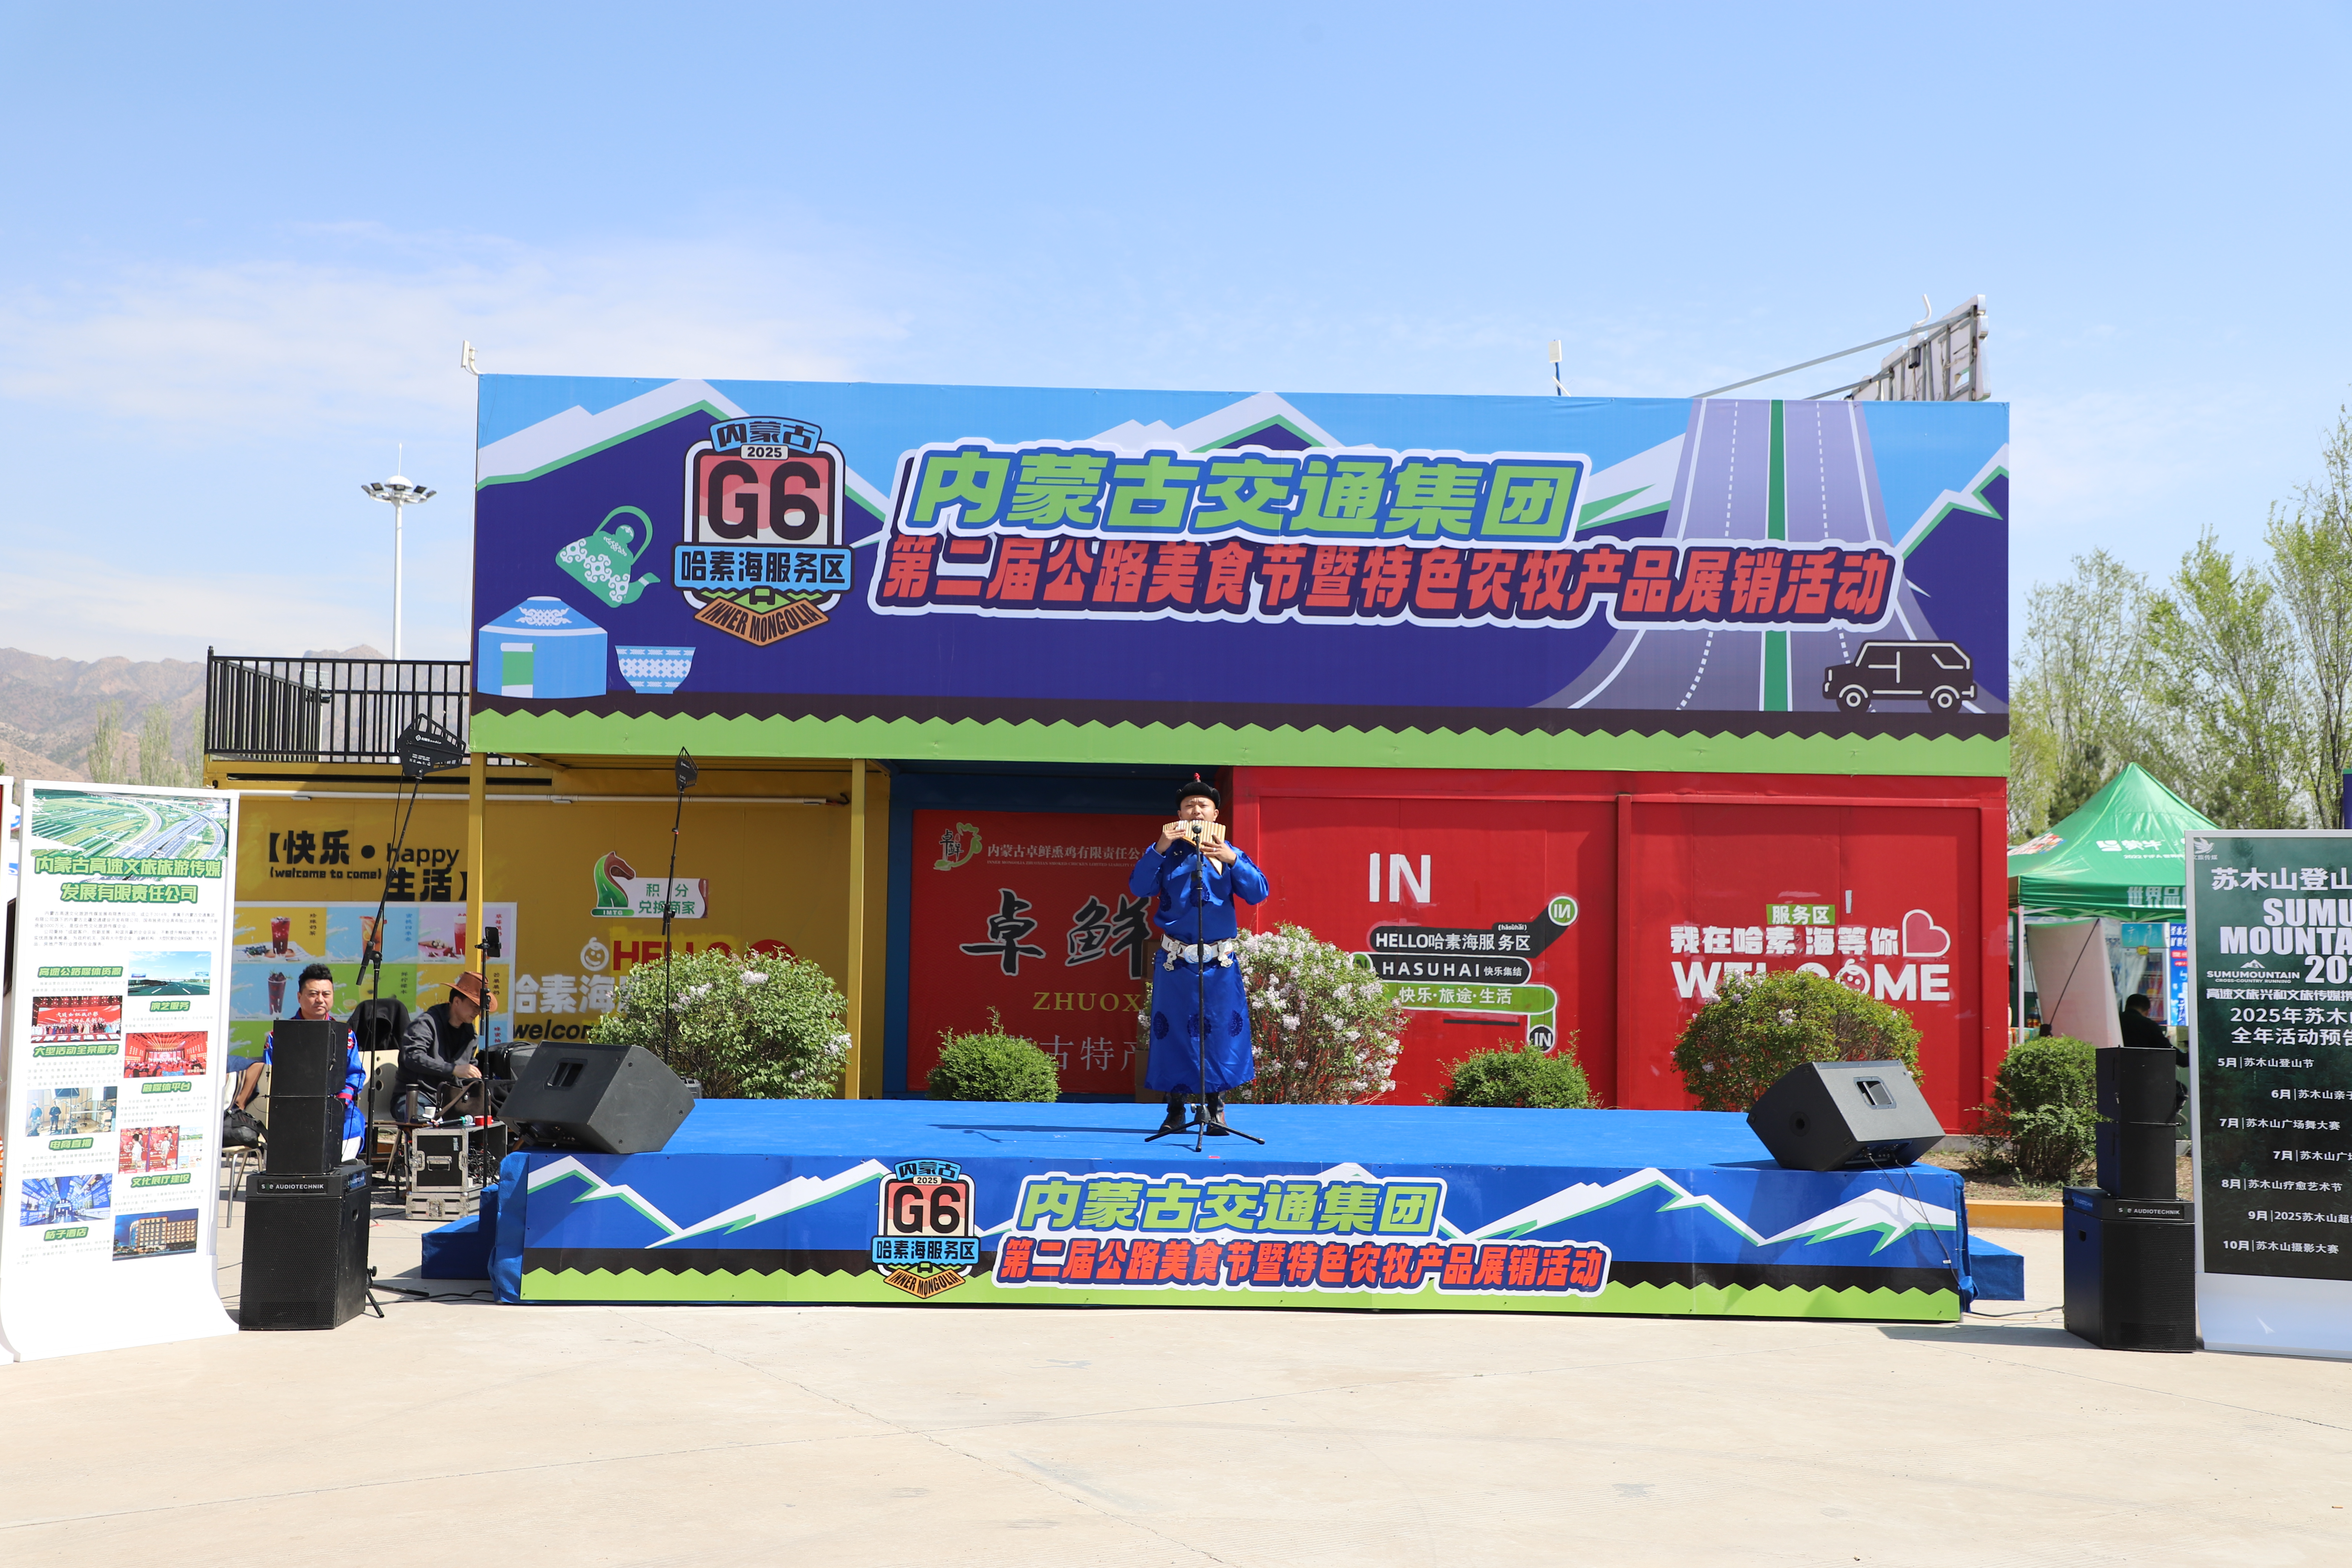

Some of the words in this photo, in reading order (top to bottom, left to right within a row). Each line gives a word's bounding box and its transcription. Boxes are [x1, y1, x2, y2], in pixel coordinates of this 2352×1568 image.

[716, 420, 816, 449] 内蒙古
[747, 447, 782, 458] 2025
[707, 460, 821, 541] G6
[914, 452, 1576, 537] 内蒙古交通集团
[681, 551, 845, 583] 哈素海服务区
[884, 534, 1889, 615] 第二届公路美食节暨特色农牧产品展销活动
[701, 602, 749, 635] INNER
[749, 603, 823, 642] MONGOLIA
[387, 843, 459, 867] happy
[35, 856, 222, 878] 内蒙古高速文旅旅游传媒
[330, 869, 343, 879] to
[1369, 852, 1431, 903] IN
[61, 883, 198, 903] 发展有限责任公司
[639, 900, 695, 915] 兑换商家
[1771, 906, 1831, 925] 服务区
[2263, 898, 2352, 927] SUMU
[959, 887, 1152, 980] 卓鲜
[1670, 925, 1899, 956] 我在哈素海等你
[2220, 926, 2352, 955] MOUNTA
[38, 967, 123, 977] 高速公路媒体资源
[1382, 962, 1480, 977] HASUHAI
[1484, 966, 1523, 977] 快乐集结
[2207, 971, 2300, 979] SUMUMOUNTAIN
[2304, 955, 2352, 984] 20
[515, 974, 637, 1014] 哈素海
[1033, 992, 1141, 1012] ZHUOX
[150, 1001, 190, 1011] 演艺服务
[2230, 1007, 2352, 1025] 2025年苏木
[513, 1019, 597, 1040] welco
[1534, 1032, 1551, 1047] IN
[142, 1082, 191, 1093] 融媒体平台
[50, 1138, 93, 1150] 电商直播
[899, 1161, 958, 1178] 内蒙古
[132, 1174, 190, 1187] 文化展厅建设
[893, 1185, 961, 1234] G6
[1021, 1181, 1438, 1232] 内蒙古交通集团
[45, 1227, 88, 1240] 桔子酒店
[876, 1240, 975, 1260] 哈素海服务区
[1001, 1239, 1603, 1286] 第二届公路美食节暨特色农牧产品展销活动
[888, 1272, 916, 1292] INNER
[917, 1271, 961, 1297] MONGOLIA
